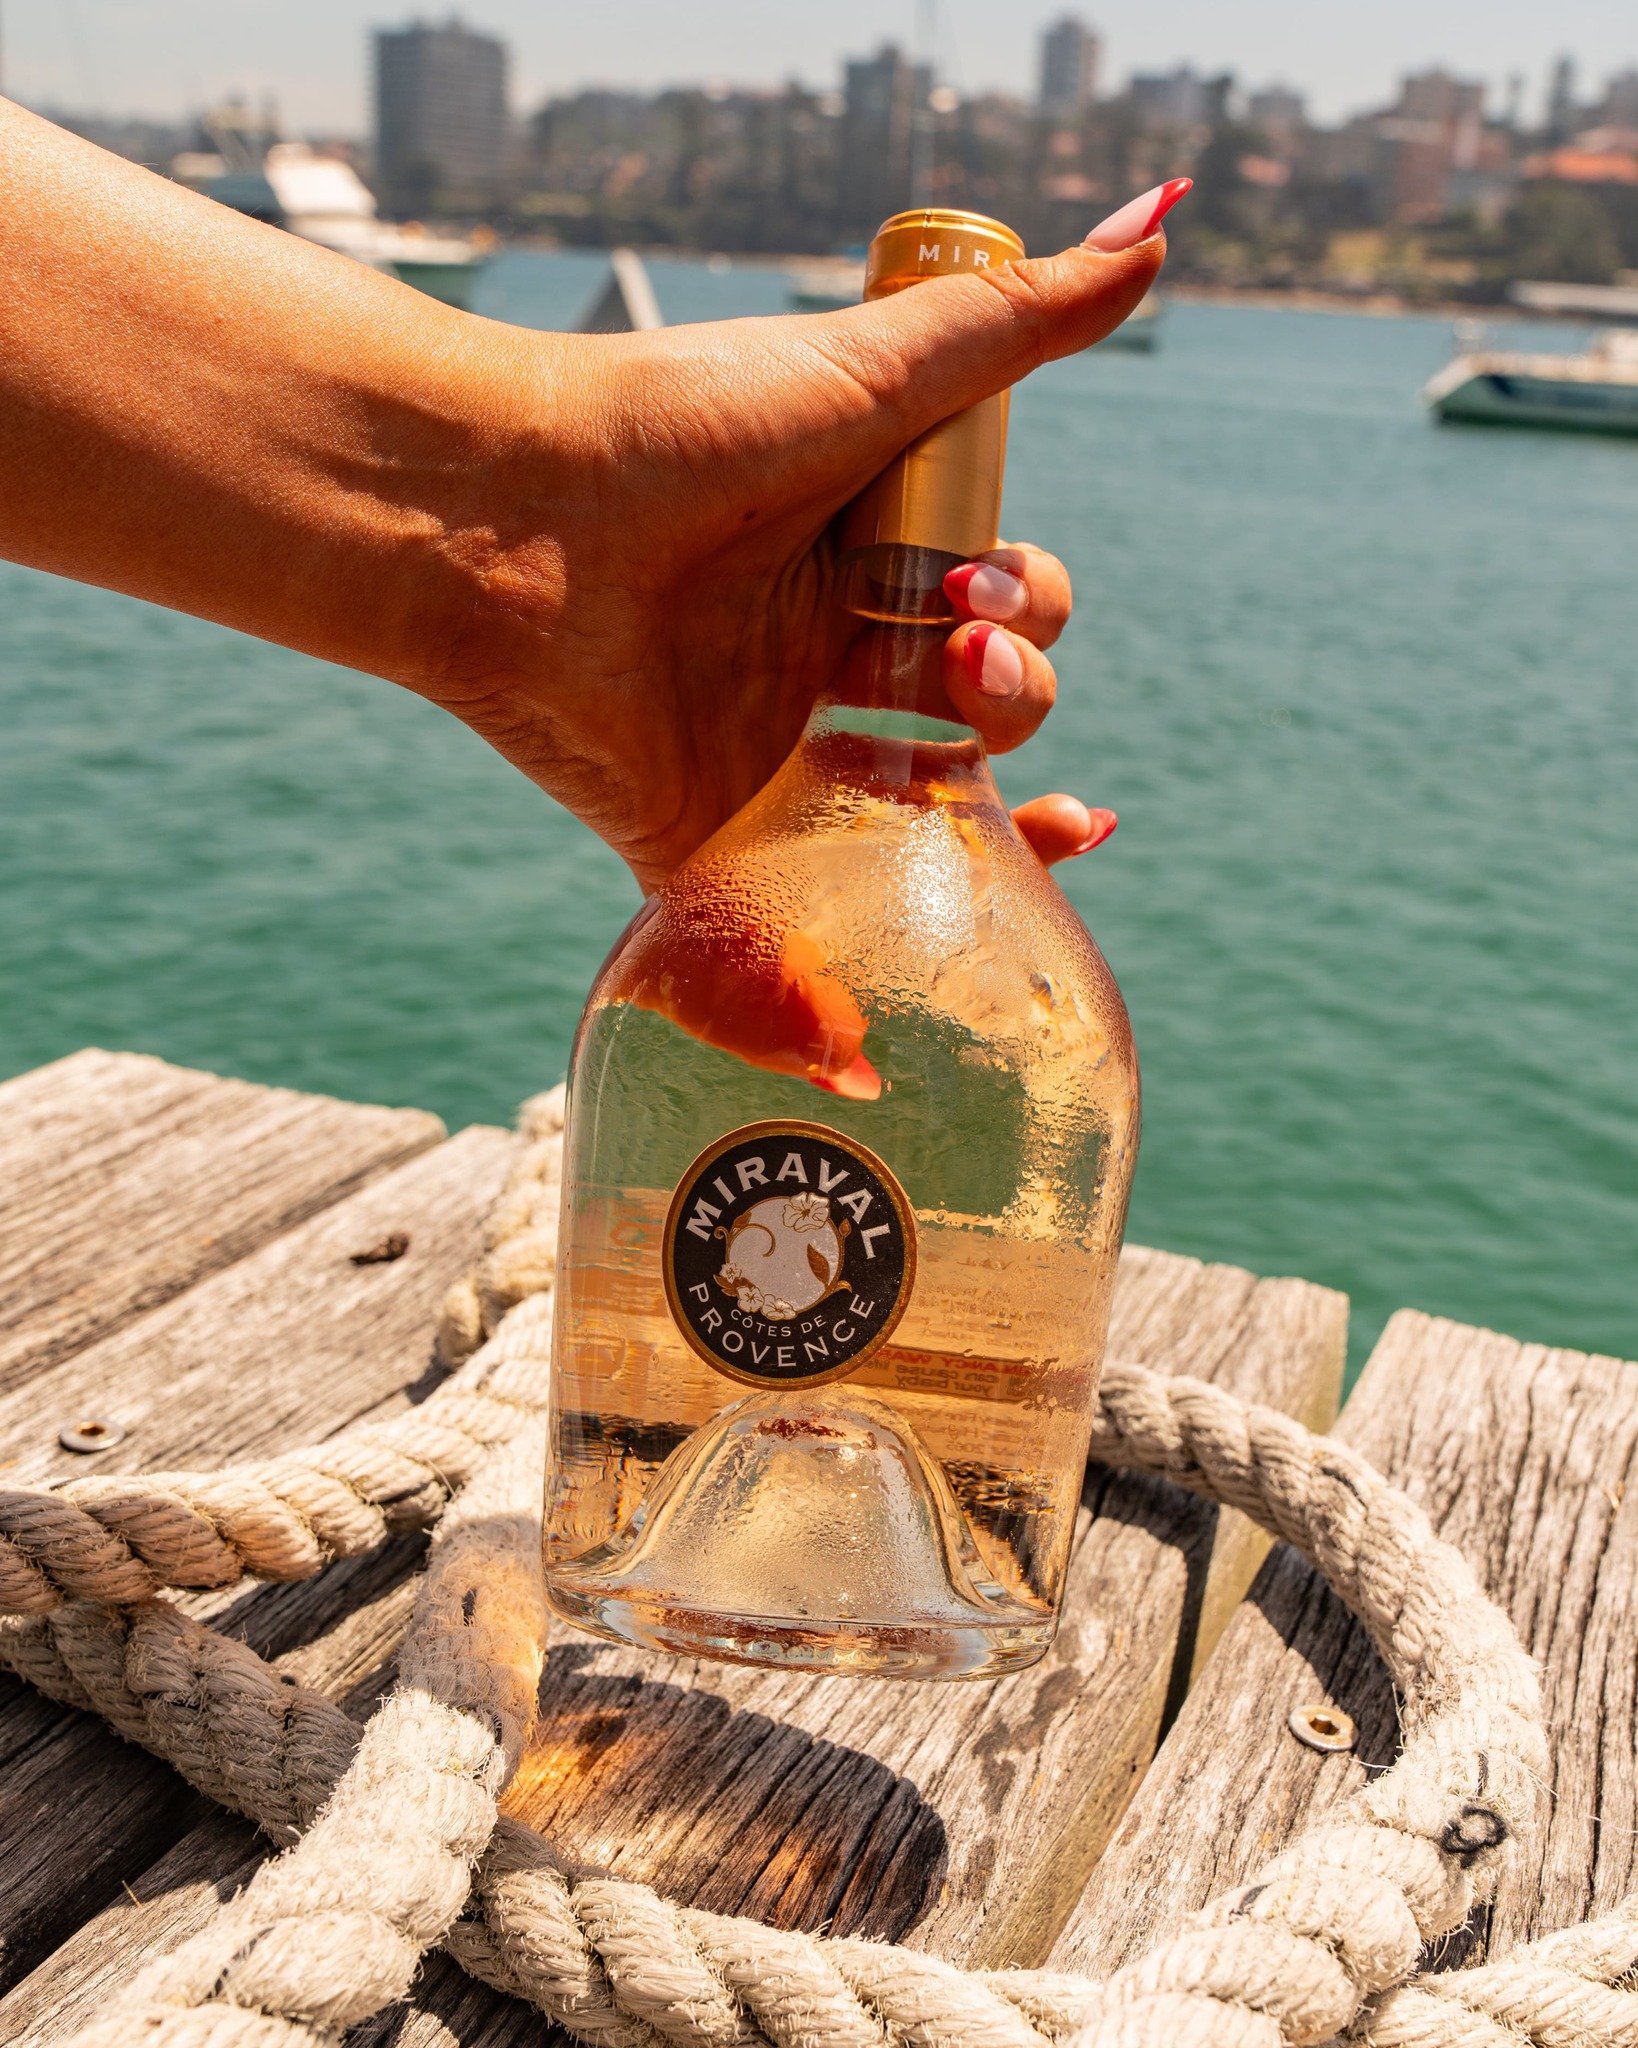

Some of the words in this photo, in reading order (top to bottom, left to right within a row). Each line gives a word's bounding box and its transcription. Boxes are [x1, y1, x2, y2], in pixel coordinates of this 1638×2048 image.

[918, 243, 1010, 270] MIR
[685, 1152, 891, 1260] MIRAVAL
[689, 1282, 874, 1368] PROVENCE
[730, 1309, 791, 1337] CÔTES
[801, 1314, 827, 1334] DE
